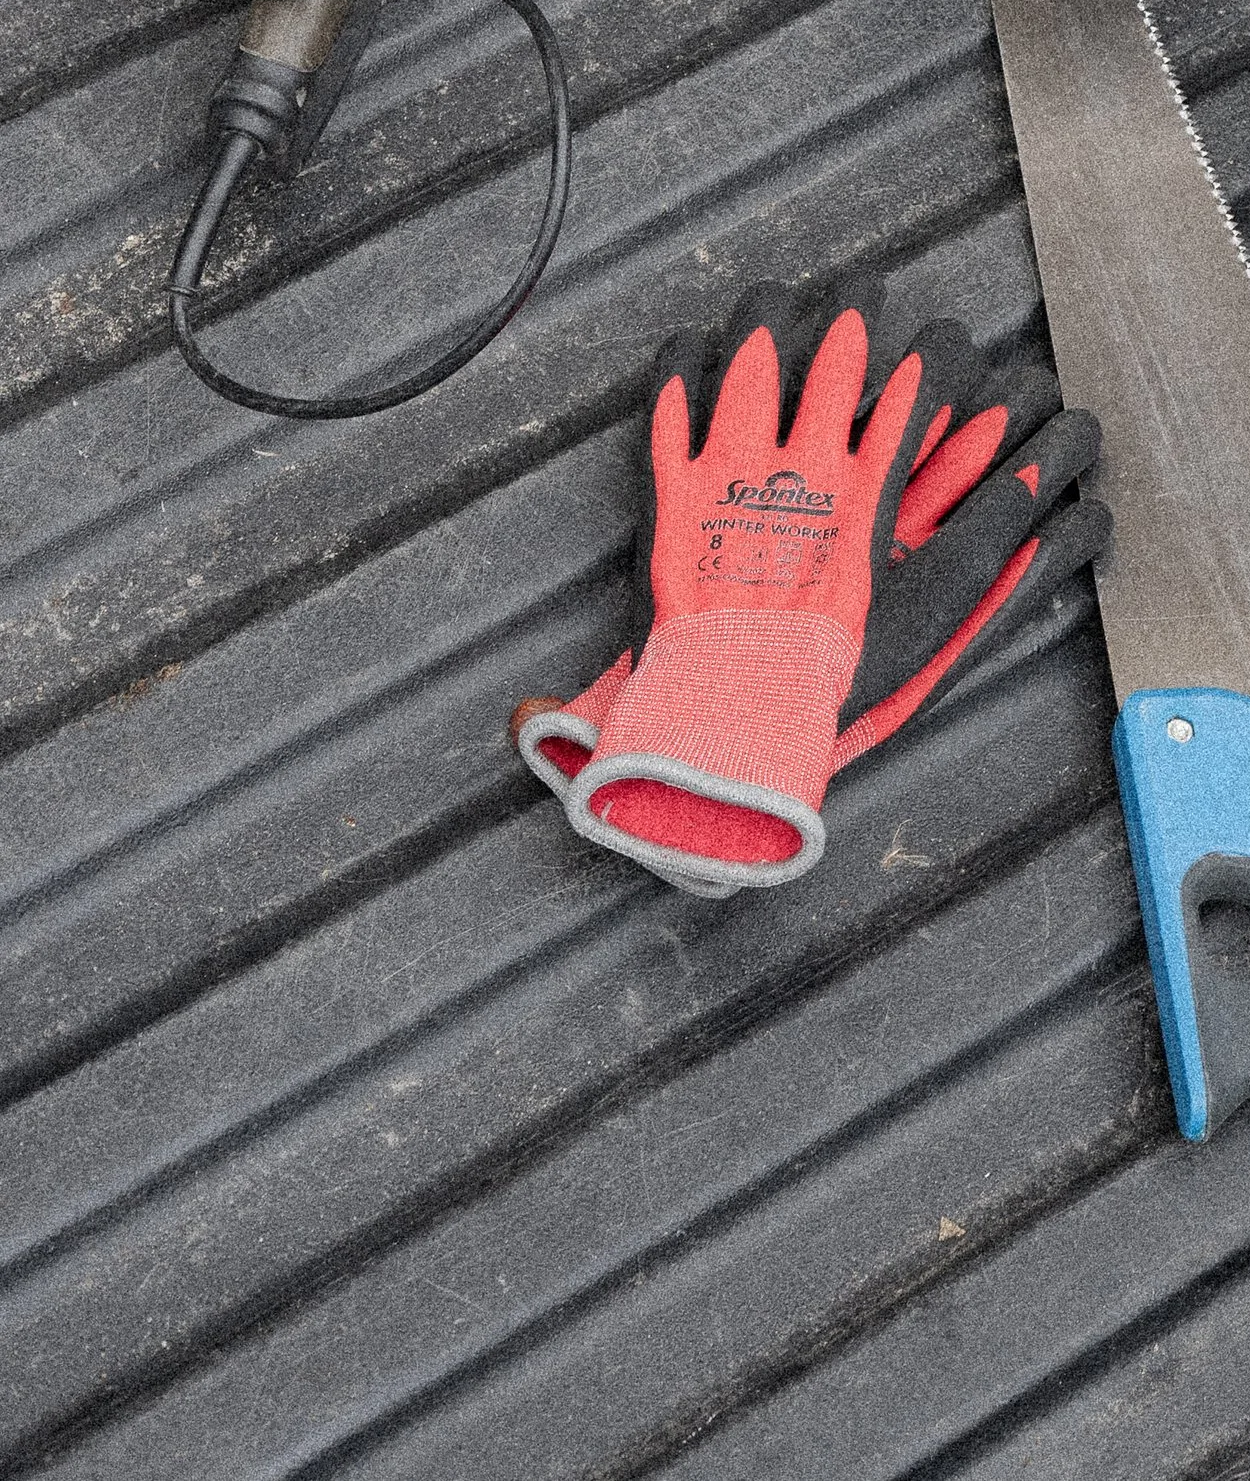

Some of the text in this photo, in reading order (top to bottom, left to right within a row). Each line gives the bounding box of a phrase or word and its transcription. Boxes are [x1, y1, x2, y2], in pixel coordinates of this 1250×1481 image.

[715, 479, 835, 508] Spontex
[701, 519, 839, 541] WINTER WORKER
[709, 533, 722, 550] 8
